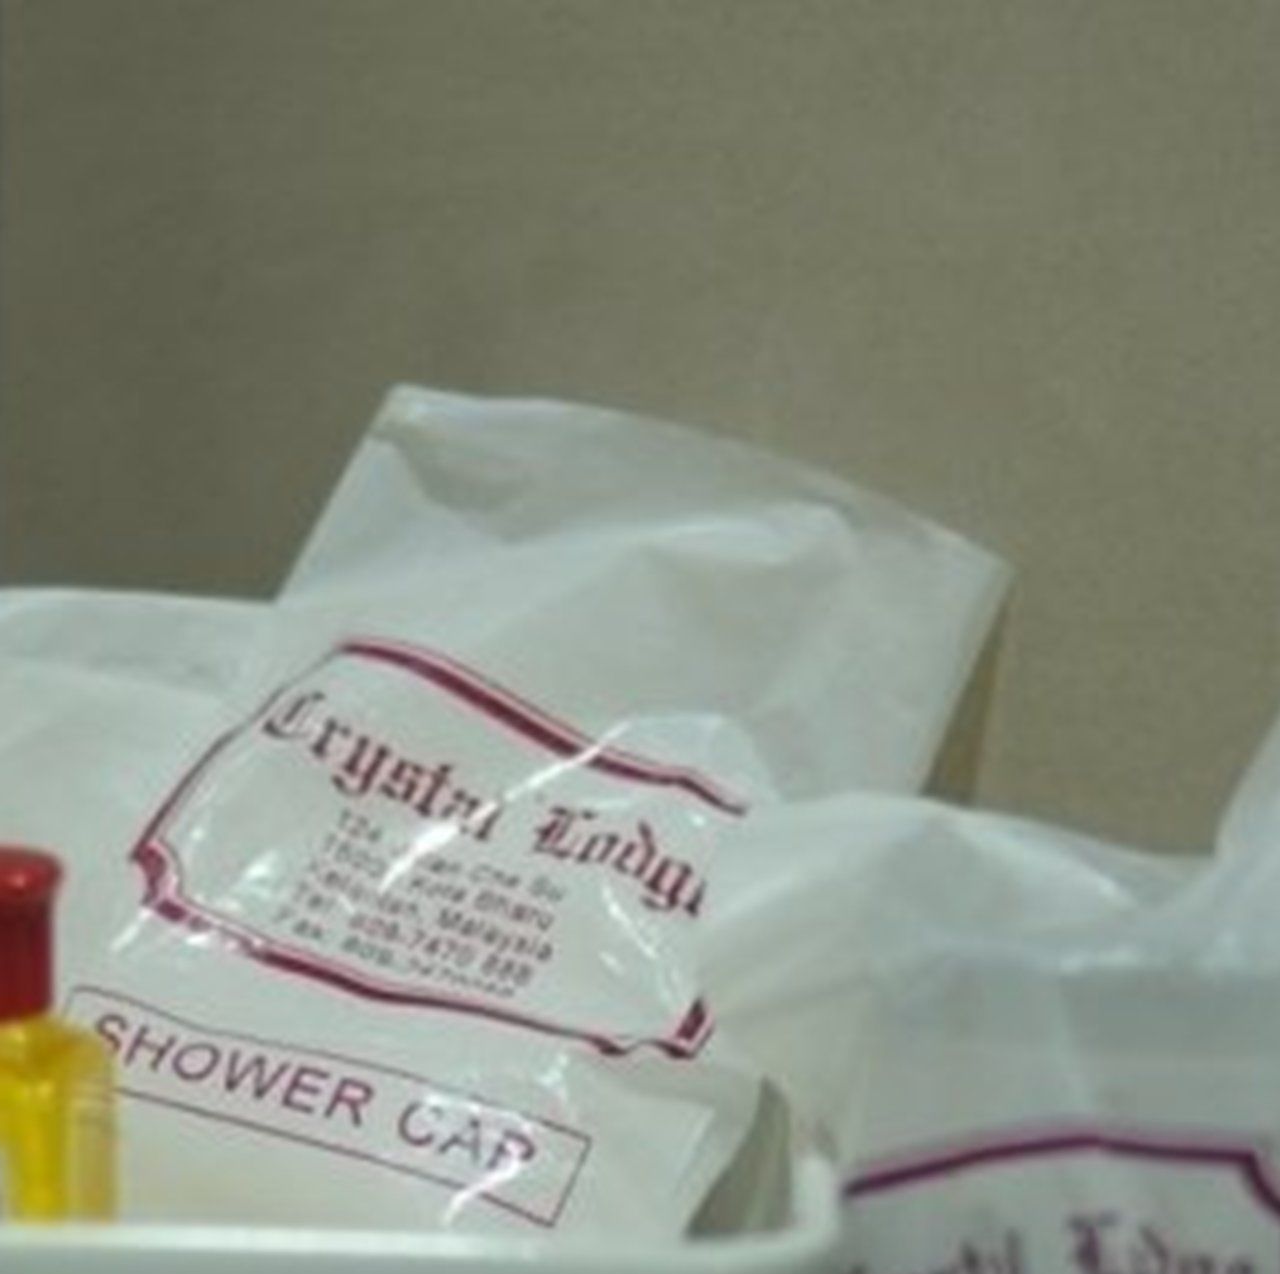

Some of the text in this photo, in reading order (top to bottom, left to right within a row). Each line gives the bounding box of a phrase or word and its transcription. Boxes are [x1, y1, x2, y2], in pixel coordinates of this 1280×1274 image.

[263, 690, 503, 843] Crystal
[437, 906, 554, 962] Malaysia
[94, 1012, 538, 1172] SHOWER CAP
